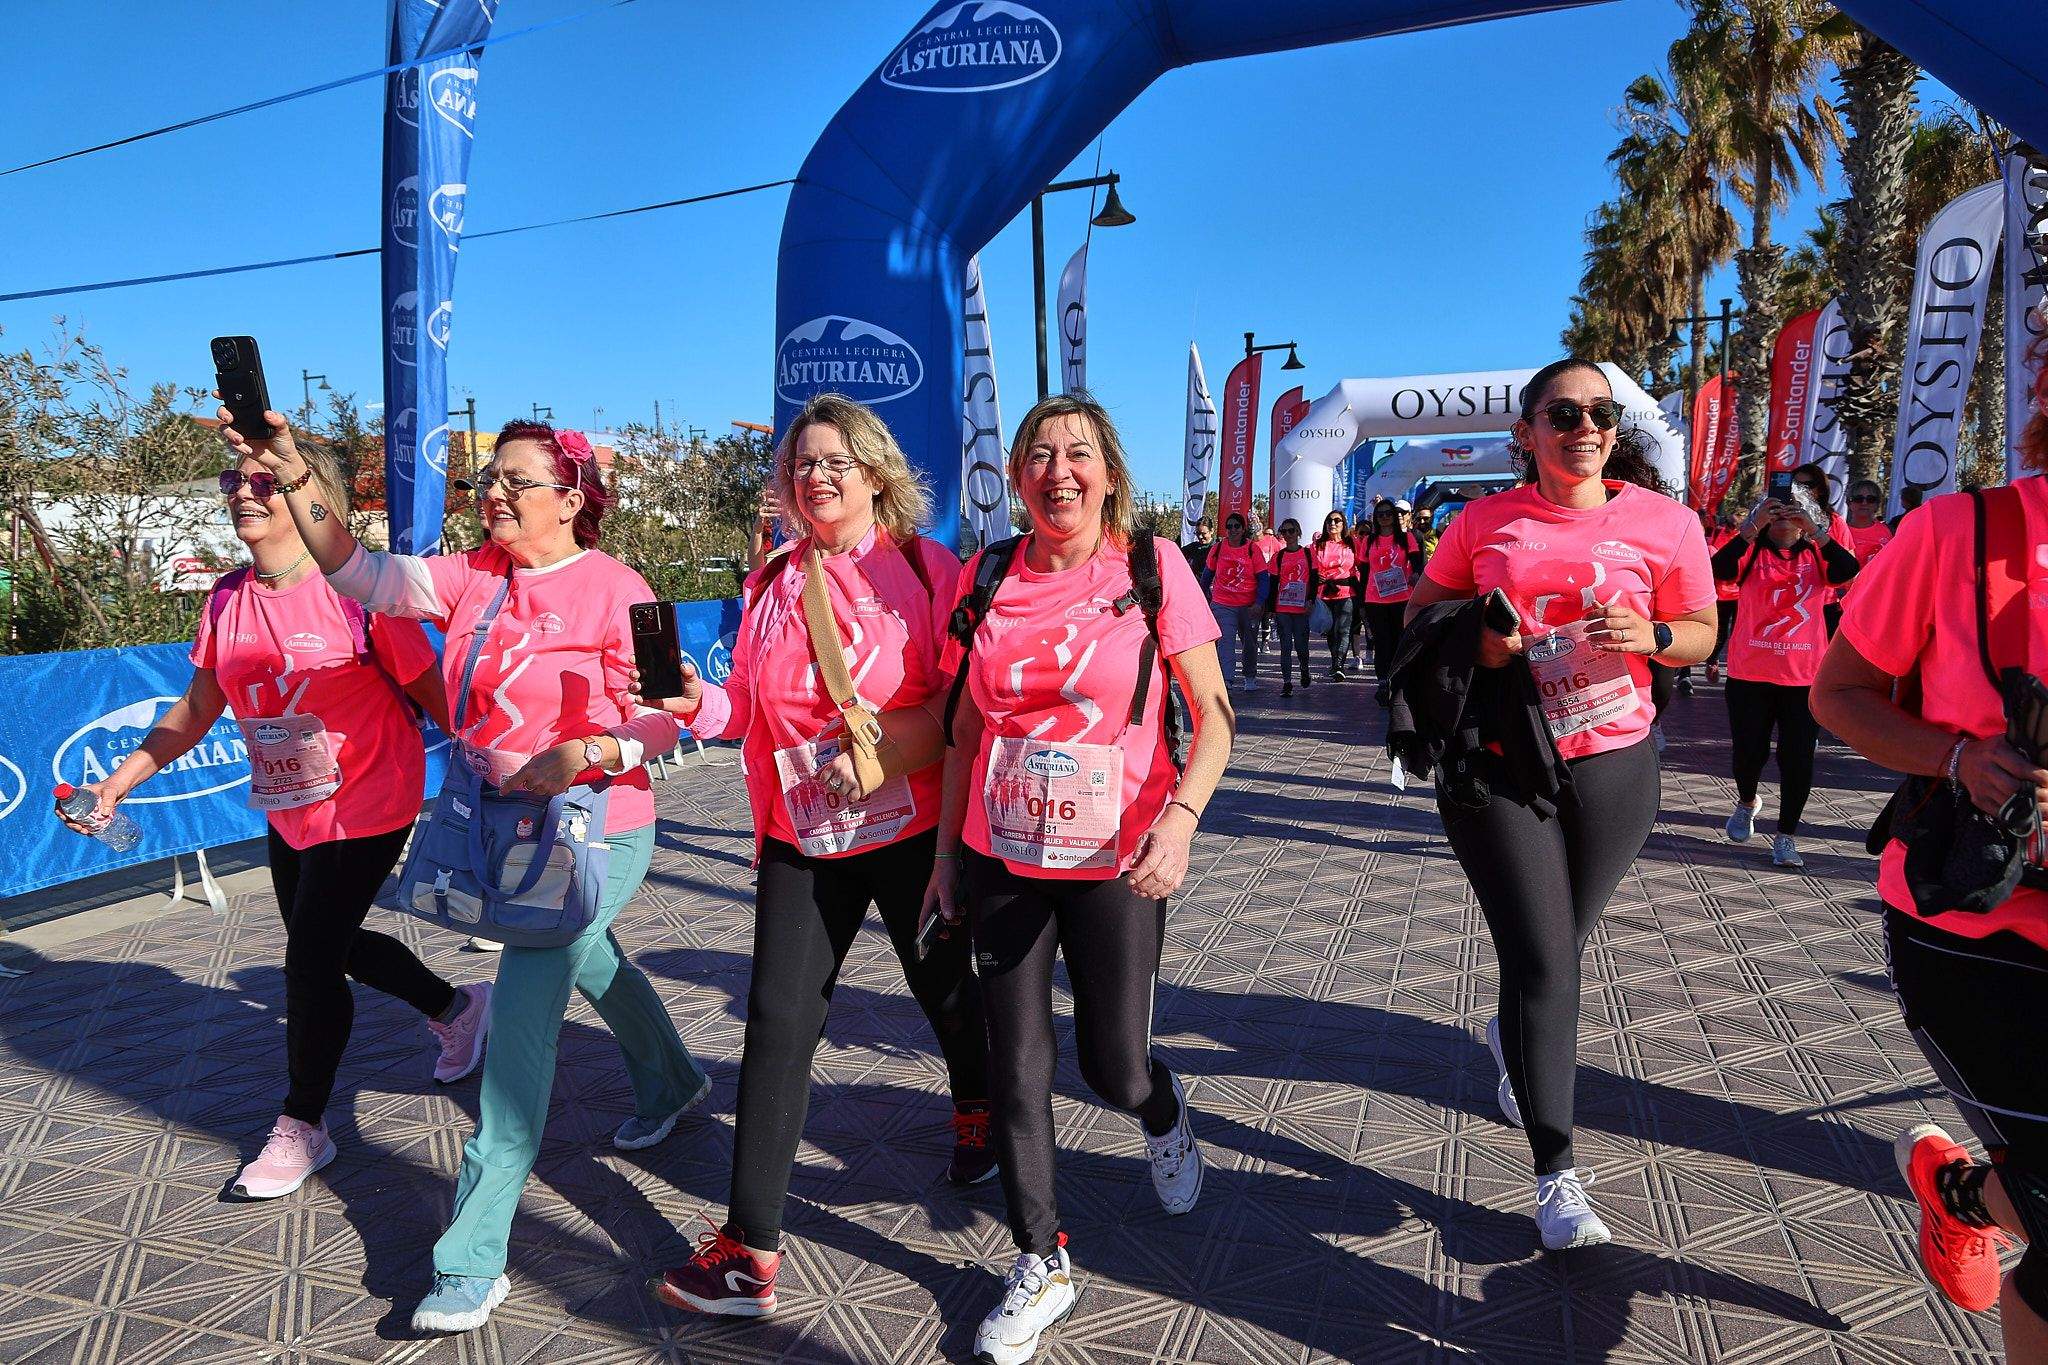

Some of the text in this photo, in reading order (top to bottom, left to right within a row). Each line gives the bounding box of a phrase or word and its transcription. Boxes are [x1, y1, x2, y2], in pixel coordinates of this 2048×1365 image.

[918, 25, 1040, 48] CENTRAL LECHERA
[889, 39, 1047, 78] ASTURIANA
[792, 347, 906, 359] CENTRAL LECHERA
[779, 354, 911, 387] ASTURIANA
[1903, 237, 1983, 491] OYSHO
[1782, 340, 1811, 440] Santander
[1391, 384, 1524, 420] OYSH
[1233, 382, 1251, 465] Santander
[1300, 427, 1346, 439] OYSHO
[1703, 397, 1720, 472] Santander
[1279, 489, 1321, 500] OYSHO
[1541, 672, 1590, 697] 016
[1557, 695, 1580, 708] 8554
[1590, 703, 1625, 721] Santander
[264, 757, 301, 775] 016
[1028, 758, 1075, 773] ASTURIANA
[273, 776, 293, 786] 2723
[837, 809, 861, 822] 2725
[872, 811, 900, 823] VALENCIA
[1027, 797, 1076, 821] 016
[1036, 823, 1057, 835] 231
[1001, 830, 1026, 841] CARRERA
[1069, 839, 1100, 848] VALENCIA
[1001, 842, 1038, 857] OYSHO
[1059, 852, 1101, 863] Santander
